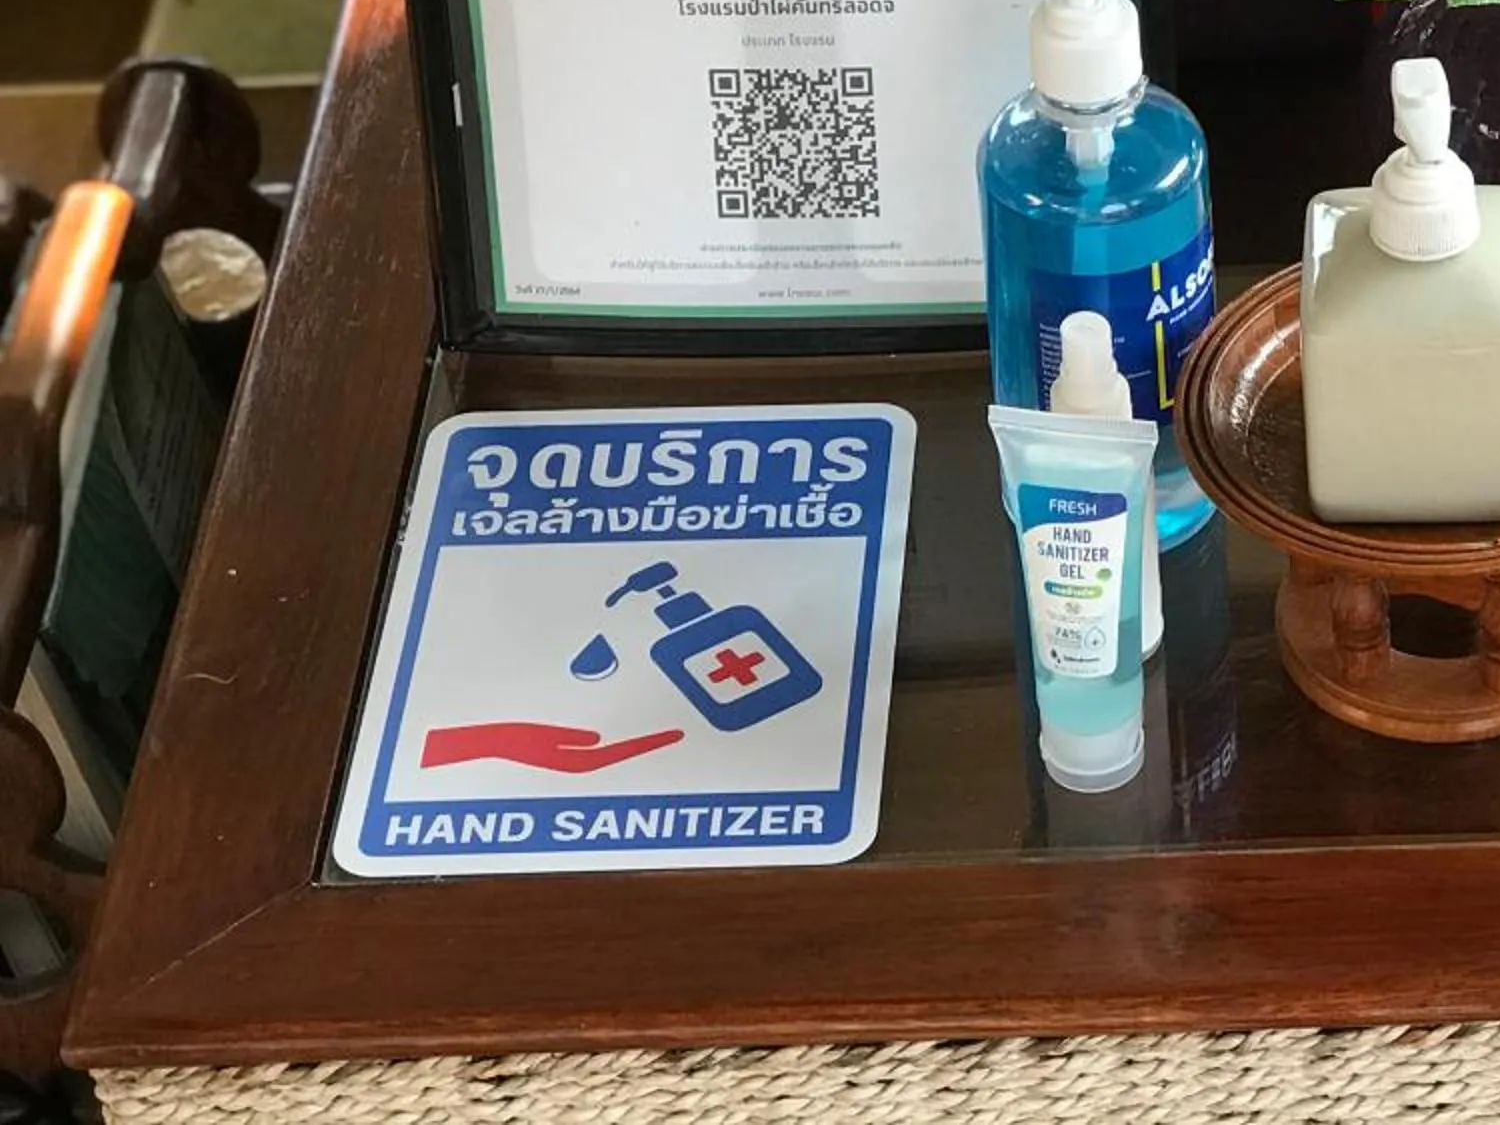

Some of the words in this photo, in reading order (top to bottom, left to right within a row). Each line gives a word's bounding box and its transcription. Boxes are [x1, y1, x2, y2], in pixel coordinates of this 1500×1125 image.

[466, 429, 869, 507] จุดบริการ
[451, 482, 862, 537] เจลล้างมือฆ่าเชื้อ
[1048, 498, 1097, 516] FRESH
[1053, 527, 1092, 544] HAND
[1037, 540, 1109, 562] SANITIZER
[1060, 563, 1085, 579] GEL
[385, 811, 535, 847] HAND
[551, 804, 826, 842] SANITIZER
